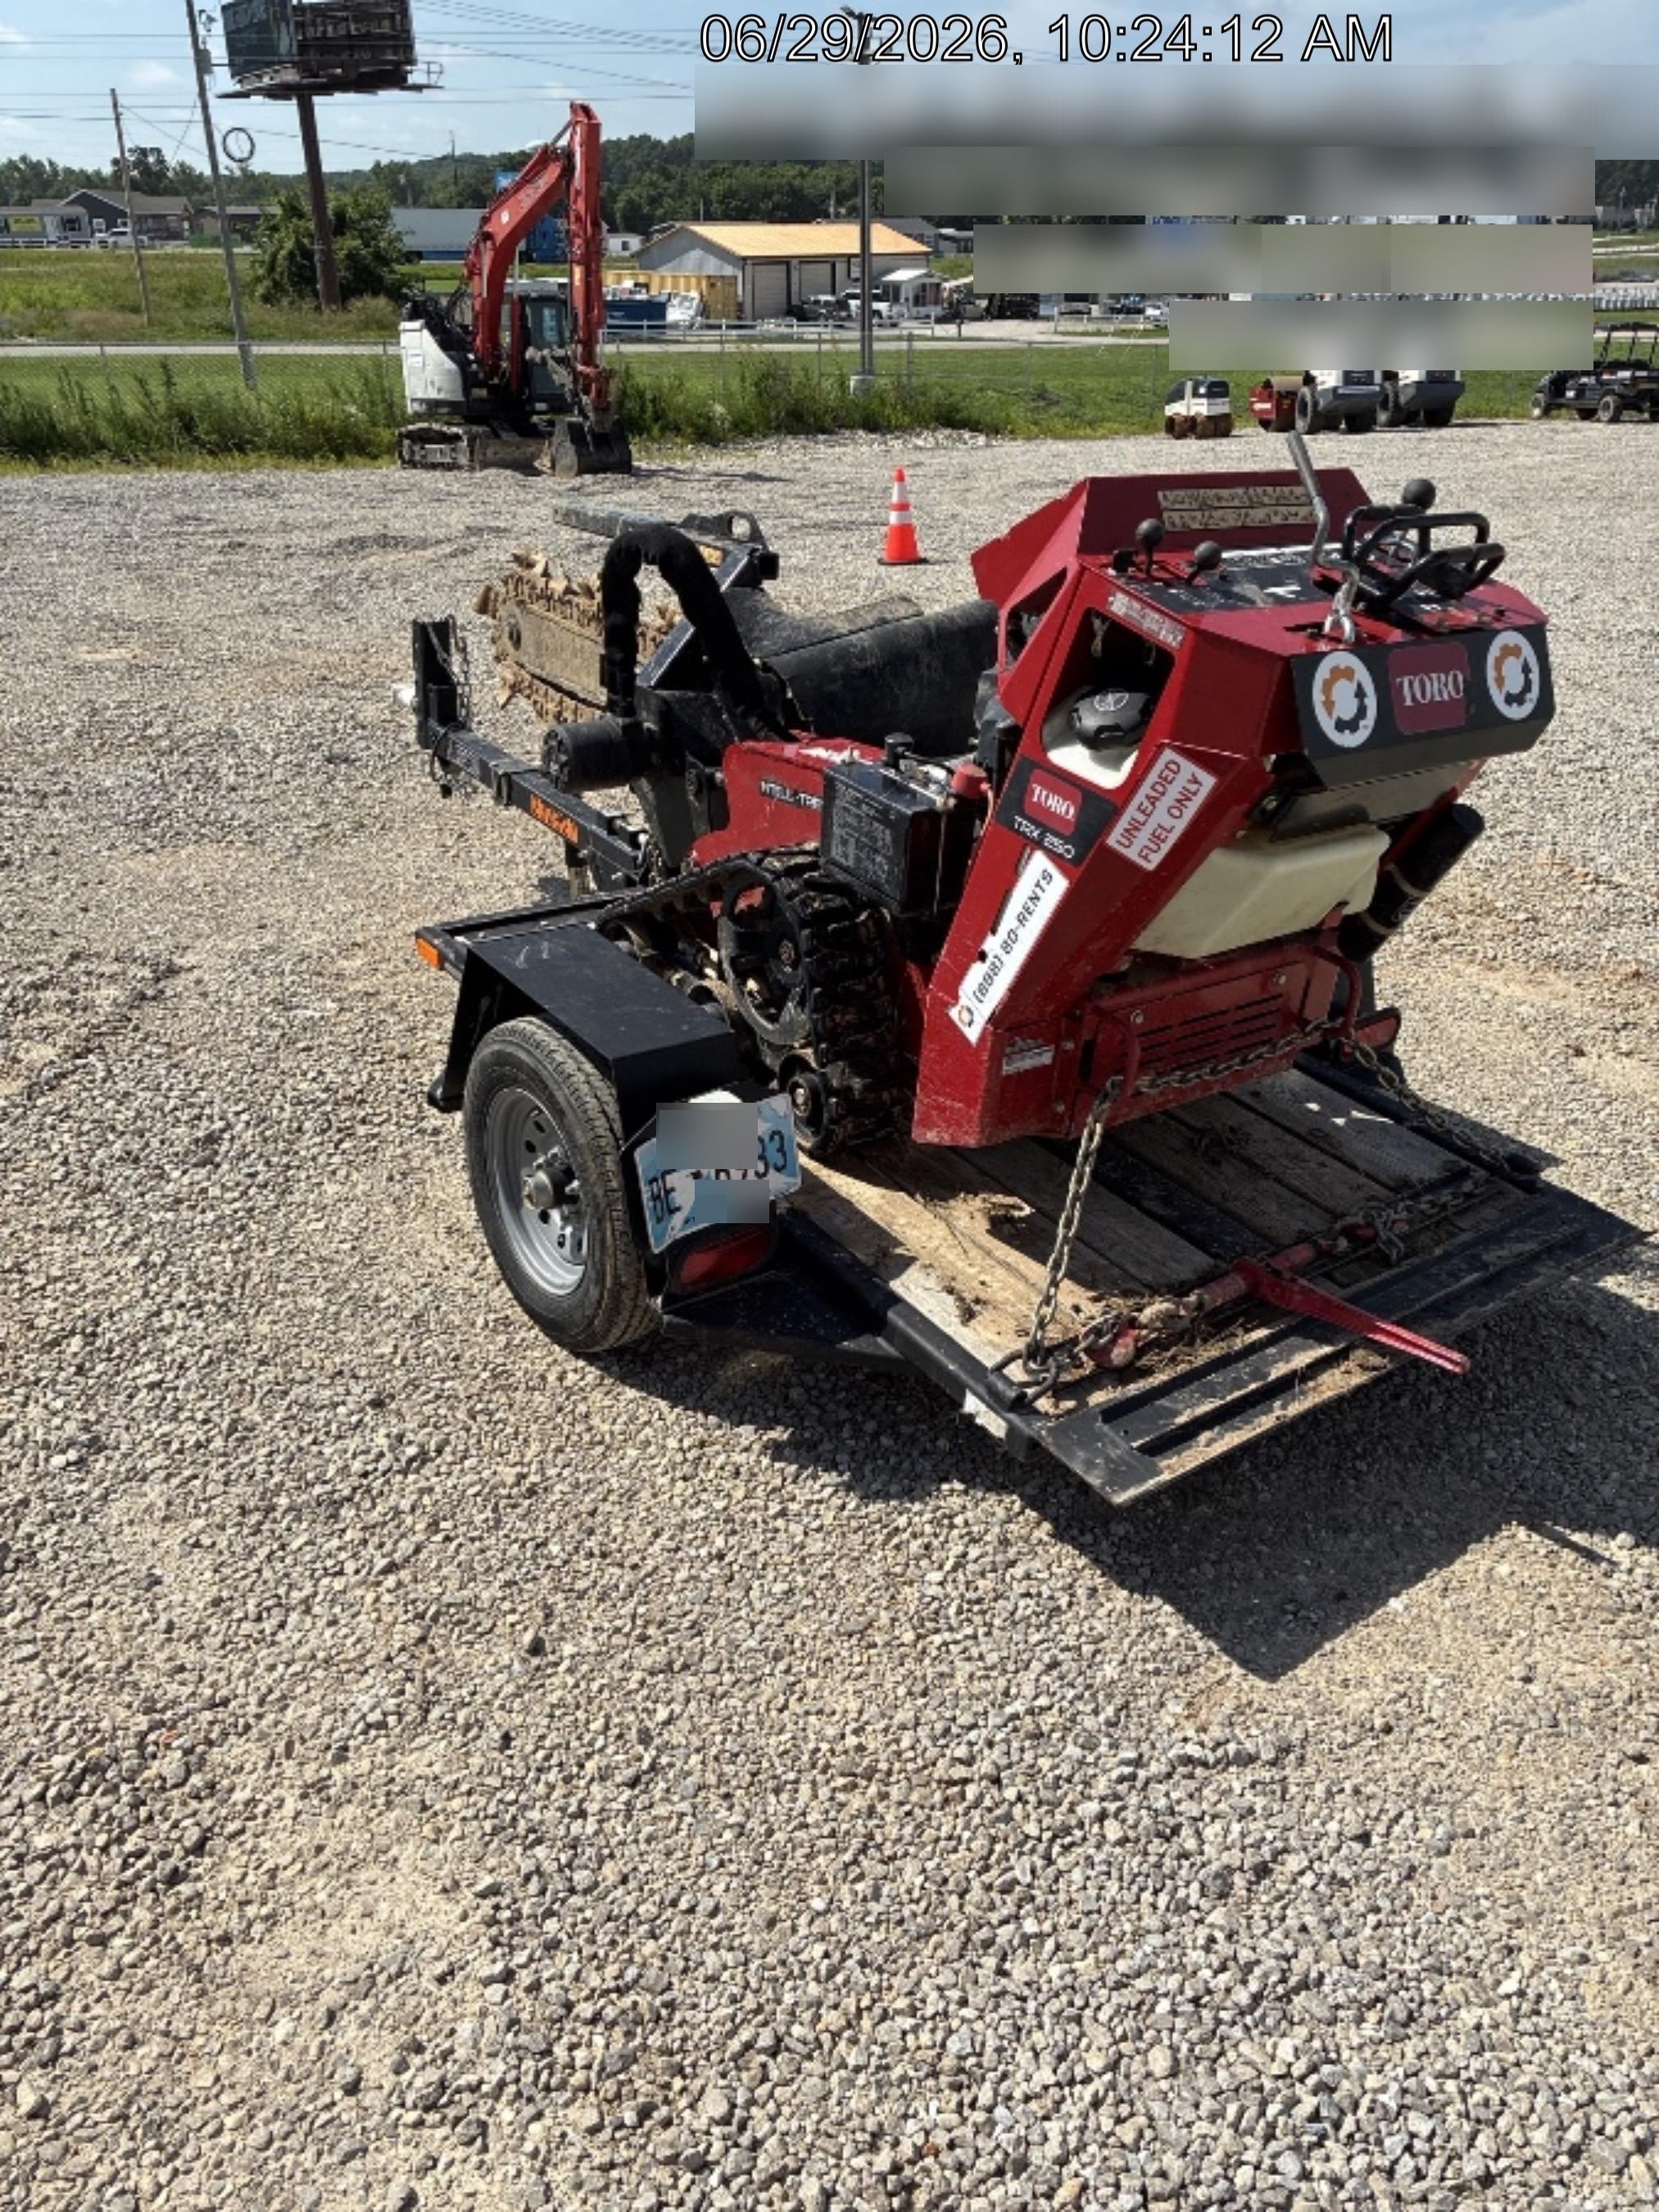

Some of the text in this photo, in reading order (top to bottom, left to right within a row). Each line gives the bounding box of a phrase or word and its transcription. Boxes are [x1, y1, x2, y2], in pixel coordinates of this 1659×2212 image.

[1396, 669, 1464, 706] TORO
[1031, 783, 1076, 821] TORO
[1115, 759, 1181, 849] UNLEADED
[1137, 772, 1203, 863] FUEL ONLY
[1014, 815, 1075, 859] TRX 250
[972, 868, 1054, 1004] (888) 80-RENTS
